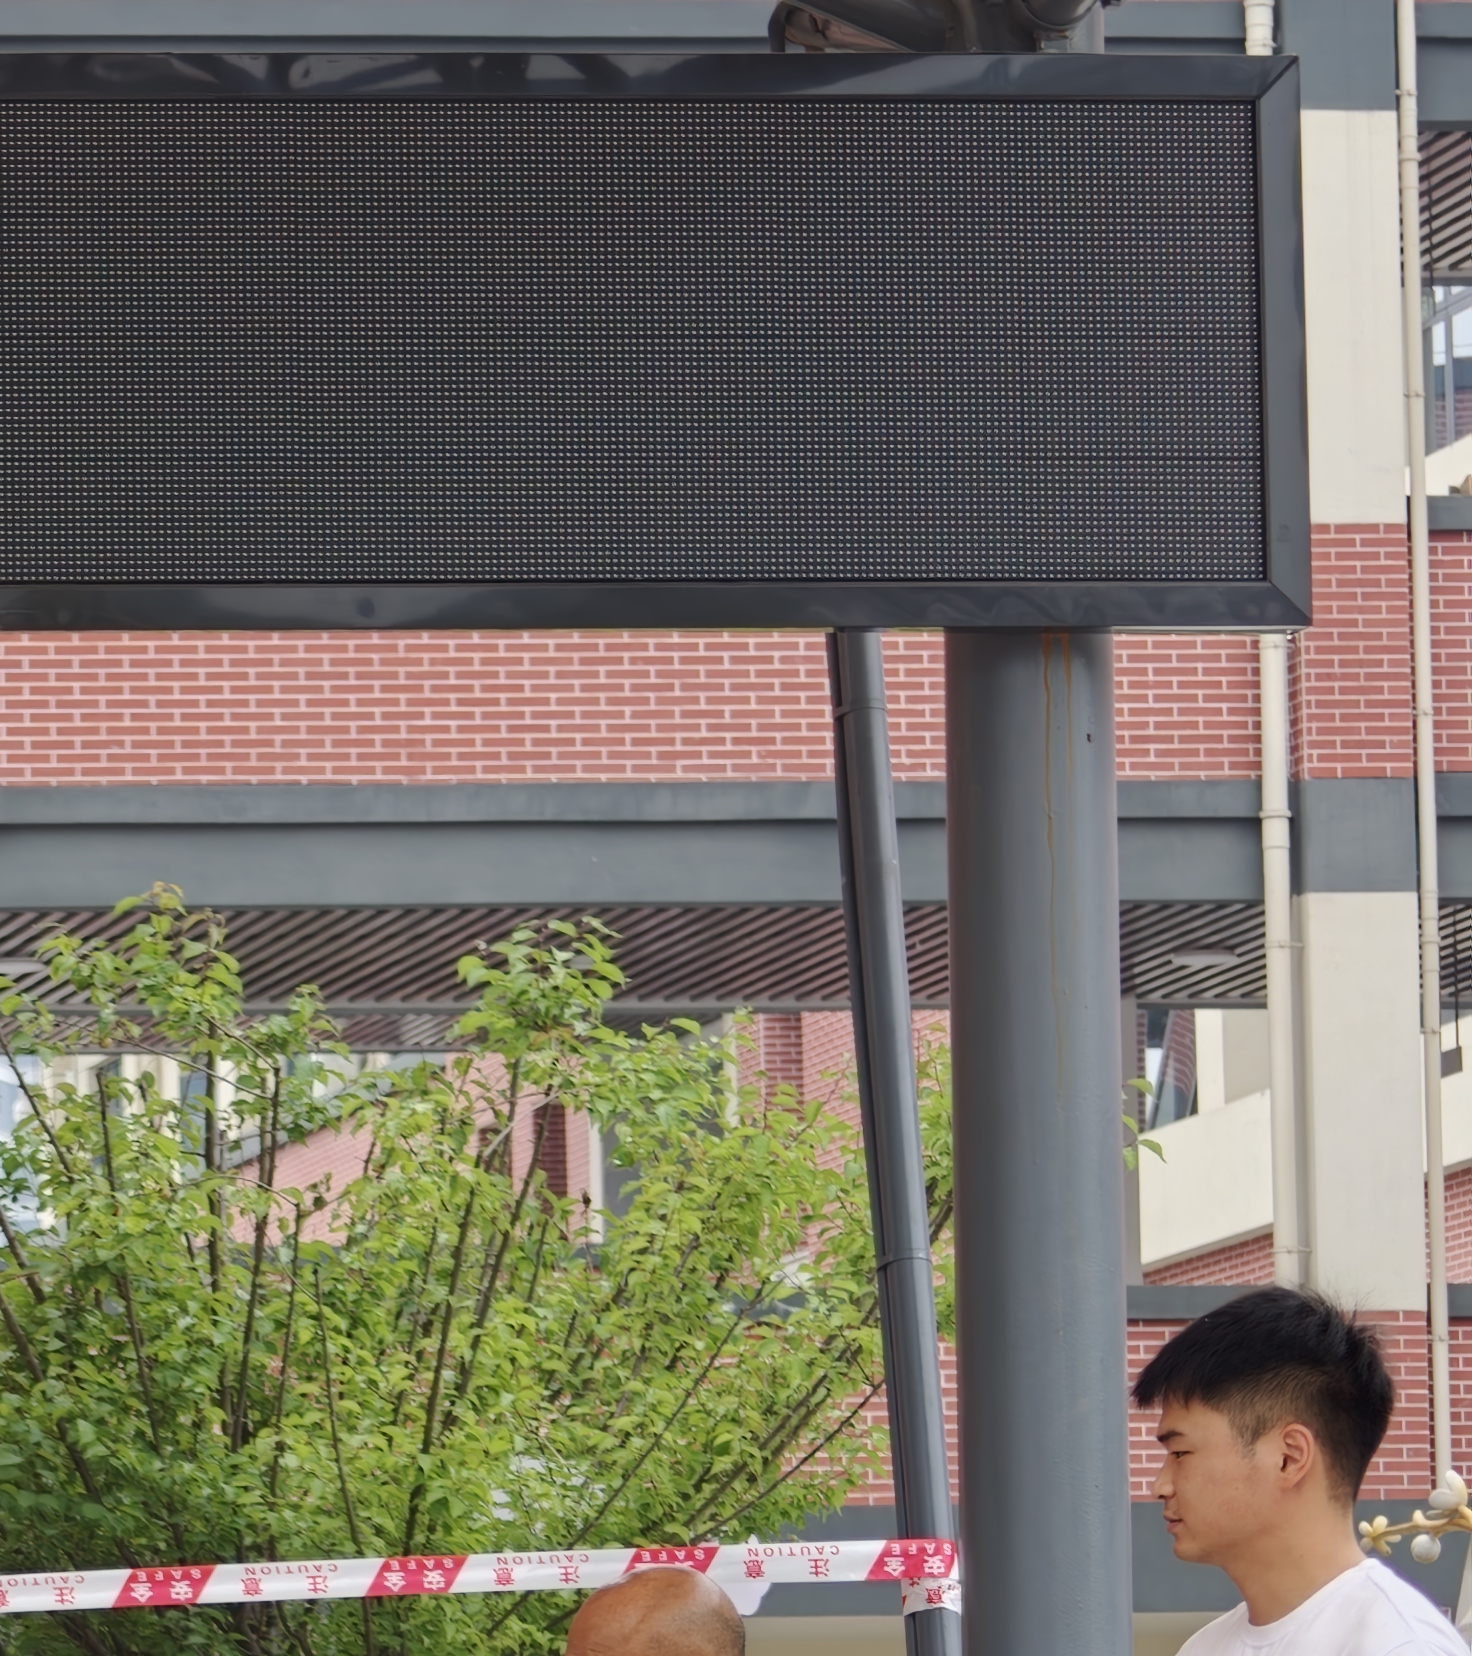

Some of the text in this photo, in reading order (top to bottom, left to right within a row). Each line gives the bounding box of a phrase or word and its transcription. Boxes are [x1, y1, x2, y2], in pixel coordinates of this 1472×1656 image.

[638, 1548, 705, 1562] SAFE
[748, 1545, 839, 1558] CAUTION
[890, 1542, 952, 1556] SAFE
[389, 1557, 453, 1570] SAFE
[496, 1553, 589, 1566] CAUTION
[883, 1555, 945, 1577] 安全
[244, 1563, 338, 1576] CAUTION
[744, 1557, 829, 1579] 注意
[137, 1569, 201, 1582] SAFE
[383, 1569, 445, 1592] 安全
[493, 1565, 580, 1587] 注意
[130, 1579, 194, 1603] 安全
[241, 1574, 328, 1597] 注意
